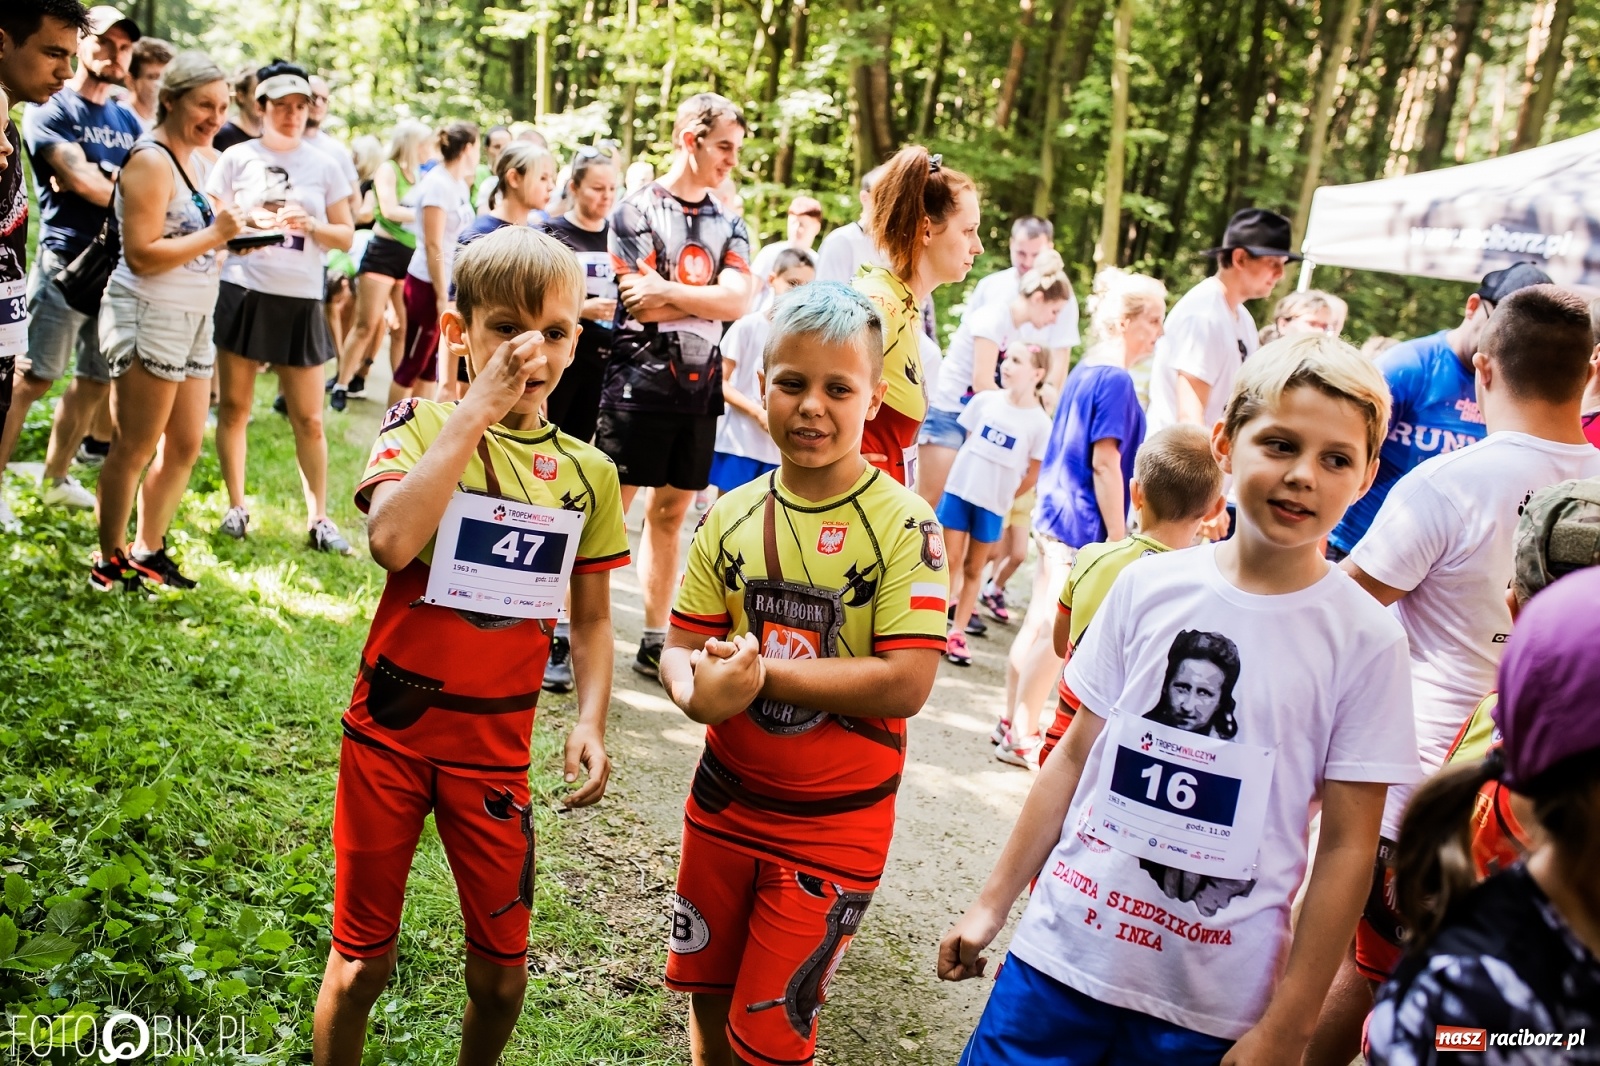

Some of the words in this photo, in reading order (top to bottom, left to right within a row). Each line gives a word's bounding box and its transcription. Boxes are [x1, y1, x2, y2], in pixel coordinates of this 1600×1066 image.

[492, 530, 546, 566] 47
[453, 564, 469, 573] 1963
[762, 699, 794, 724] OCR
[1108, 794, 1120, 805] 1963
[1140, 763, 1199, 810] 16
[1185, 822, 1207, 832] godz.
[1209, 827, 1231, 837] 11.00
[1053, 861, 1099, 899] DANUTA
[1106, 890, 1232, 945] SIEDZIKÓWNA
[672, 910, 692, 941] B
[1084, 908, 1102, 930] P.
[1115, 922, 1163, 952] INKA
